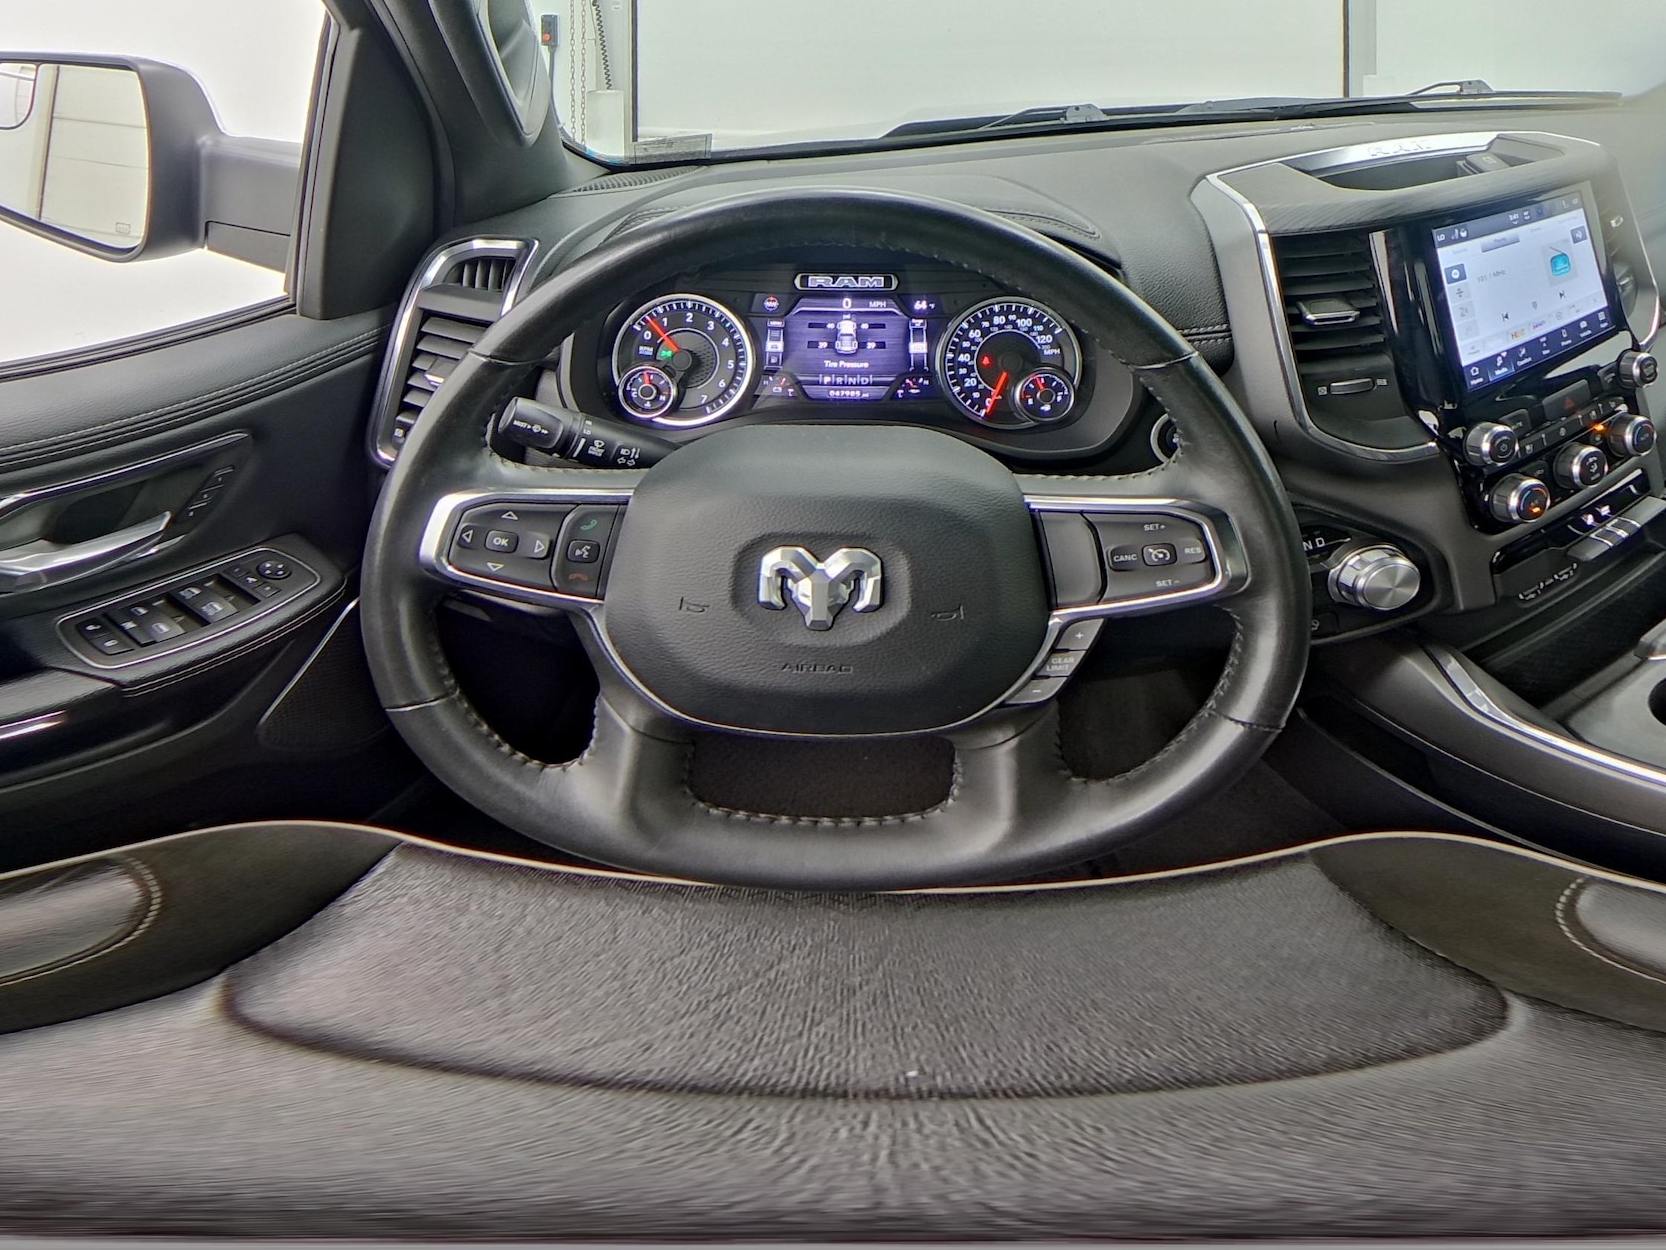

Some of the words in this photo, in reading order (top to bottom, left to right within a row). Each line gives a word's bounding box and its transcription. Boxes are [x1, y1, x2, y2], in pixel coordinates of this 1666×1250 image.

[808, 276, 884, 288] RAM
[842, 298, 851, 309] 0
[914, 300, 927, 309] 64
[663, 318, 668, 326] 1
[686, 313, 693, 323] 2
[993, 316, 1006, 325] 80
[1016, 318, 1032, 327] 100
[707, 321, 715, 330] 3
[644, 331, 652, 340] 0
[968, 330, 981, 338] 60
[722, 338, 729, 347] 4
[1036, 334, 1052, 344] 120
[958, 354, 970, 362] 40
[728, 360, 734, 369] 5
[824, 360, 838, 368] Tire
[839, 360, 869, 368] Pressure
[719, 380, 725, 388] 6
[824, 377, 831, 385] P
[837, 377, 844, 385] R
[848, 377, 857, 385] N
[861, 377, 869, 385] D
[964, 378, 977, 387] 20
[701, 395, 707, 403] 7
[493, 537, 509, 546] OK
[1316, 537, 1325, 548] D
[1184, 546, 1201, 554] RES
[1113, 554, 1137, 562] CANC
[781, 663, 853, 674] AIRBAG
